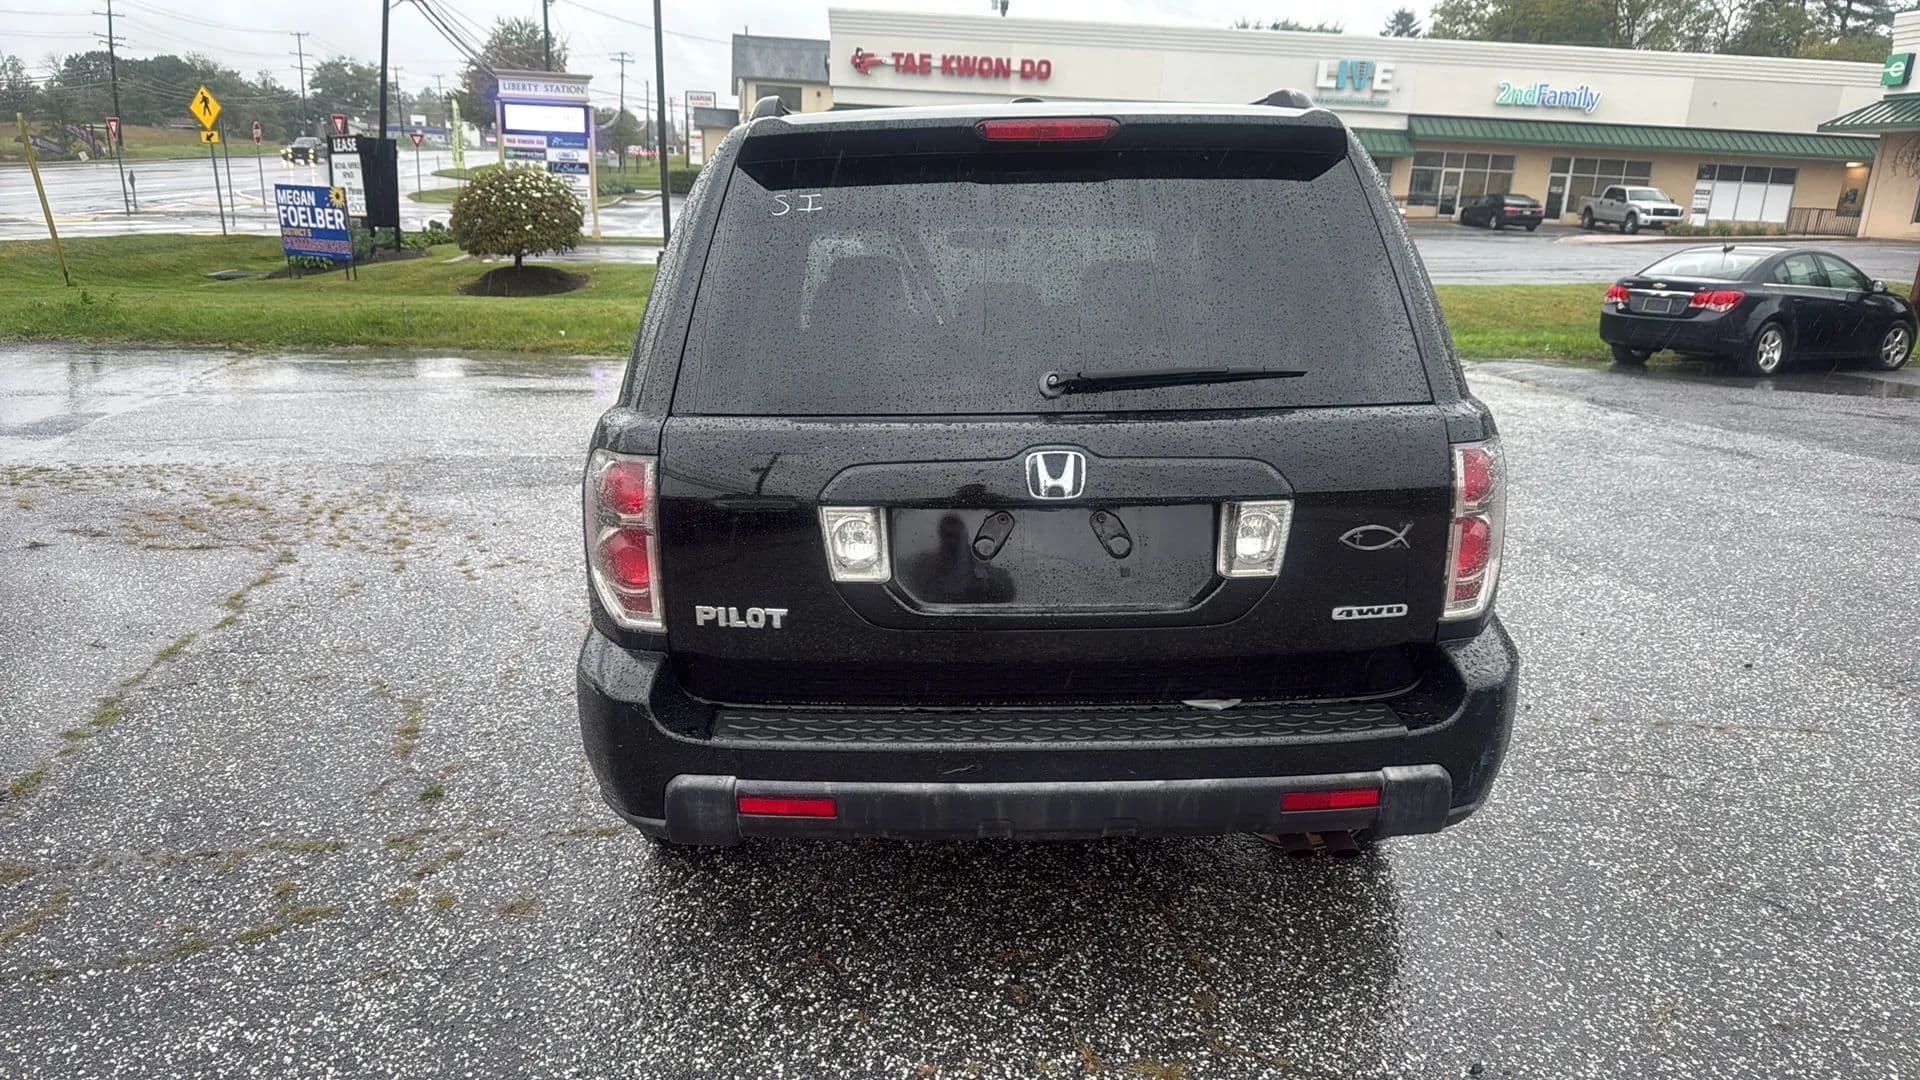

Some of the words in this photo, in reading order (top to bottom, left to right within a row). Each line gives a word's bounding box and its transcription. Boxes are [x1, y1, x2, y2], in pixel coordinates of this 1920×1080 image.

[891, 52, 932, 75] TAE
[940, 54, 1011, 79] KWON
[1020, 58, 1051, 80] DO
[1316, 59, 1396, 91] LIVE
[502, 82, 538, 92] LIBERTY
[544, 84, 584, 94] STATION
[1496, 80, 1602, 113] 2ndFamily
[333, 138, 358, 151] LEASE
[277, 188, 316, 206] MEGAN
[279, 205, 347, 230] FOELBER
[695, 605, 788, 629] PILOT
[1336, 605, 1405, 618] 4WD
